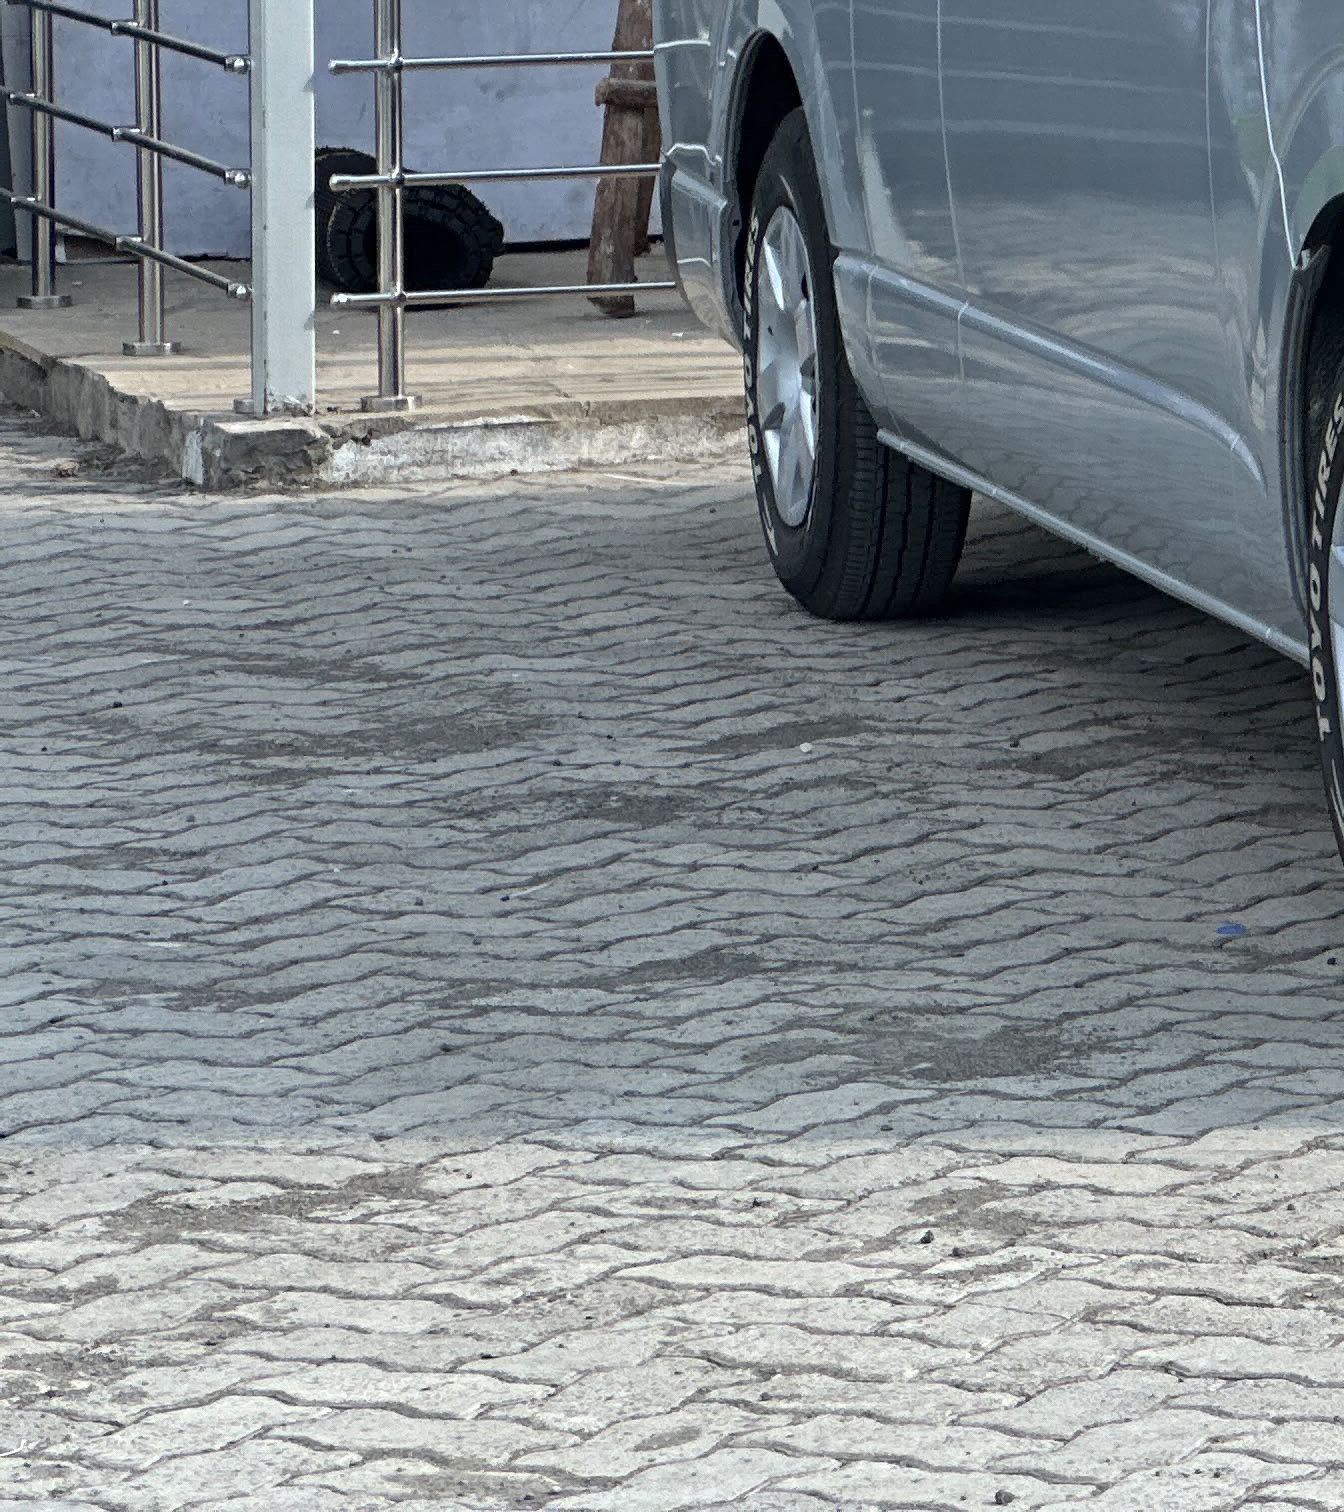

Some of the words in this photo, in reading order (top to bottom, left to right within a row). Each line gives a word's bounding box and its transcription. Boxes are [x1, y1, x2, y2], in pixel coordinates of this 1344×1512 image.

[743, 207, 760, 341] TIRES
[744, 353, 762, 485] TOYO
[1310, 562, 1331, 742] TOYO
